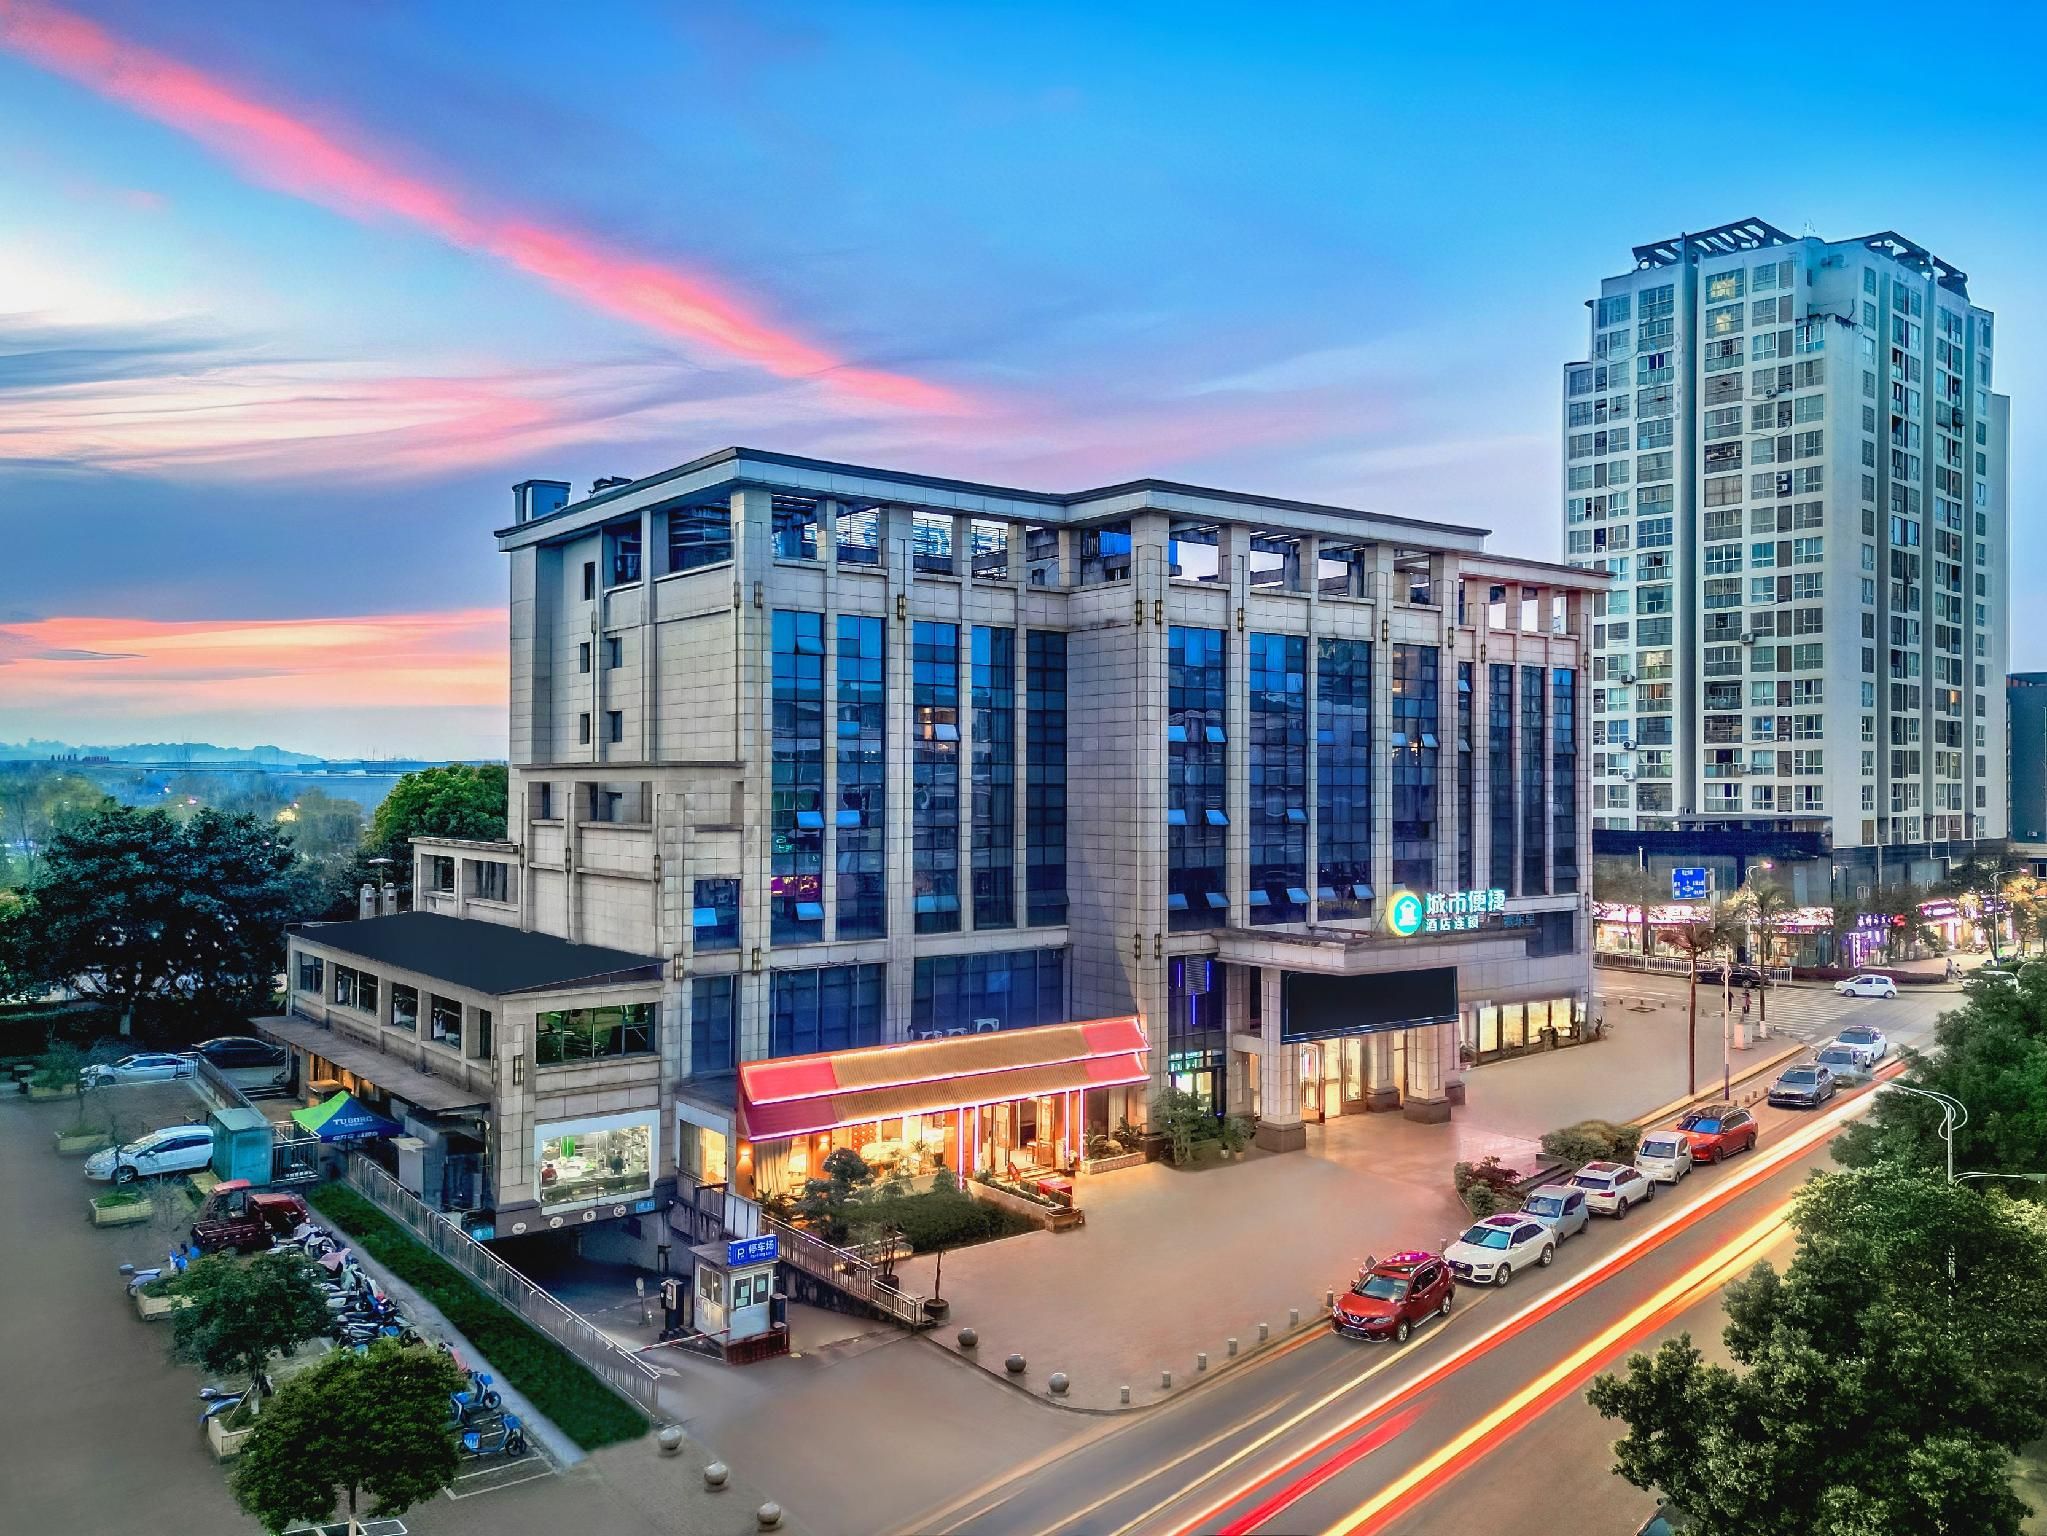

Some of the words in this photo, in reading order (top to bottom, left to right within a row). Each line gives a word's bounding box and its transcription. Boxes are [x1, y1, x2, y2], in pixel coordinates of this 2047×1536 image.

[1426, 889, 1506, 914] 城市便捷
[1426, 914, 1479, 931] 酒店连锁
[333, 1116, 373, 1125] TUBORG
[737, 1248, 744, 1260] P
[749, 1240, 774, 1254] 停车场
